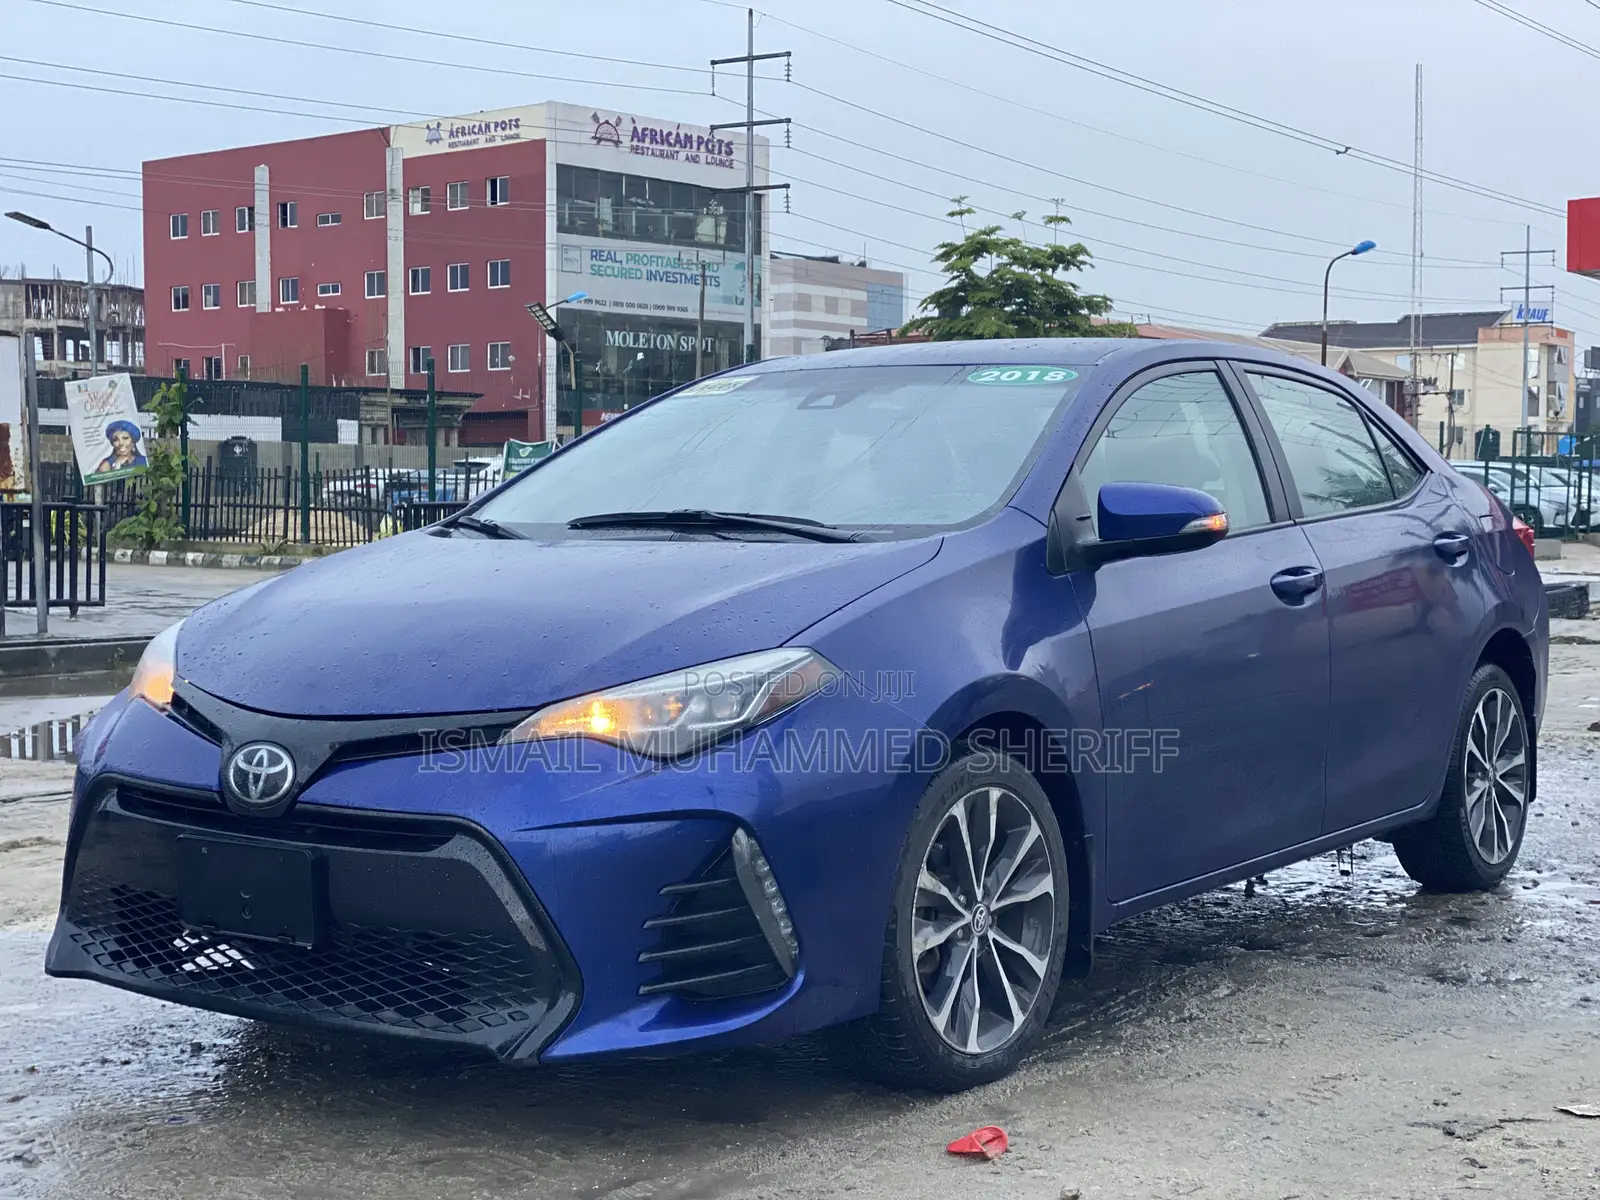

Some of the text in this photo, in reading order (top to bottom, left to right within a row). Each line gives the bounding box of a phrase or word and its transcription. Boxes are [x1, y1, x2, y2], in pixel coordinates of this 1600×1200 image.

[494, 117, 521, 132] POTS
[485, 134, 496, 143] AND
[630, 144, 735, 169] RESTAURANT AND LOUNGE
[590, 249, 623, 266] REAL,
[625, 252, 693, 271] PROFITABLE
[590, 263, 643, 280] SECURED
[605, 330, 678, 350] MOLETON
[976, 370, 1067, 381] 2018
